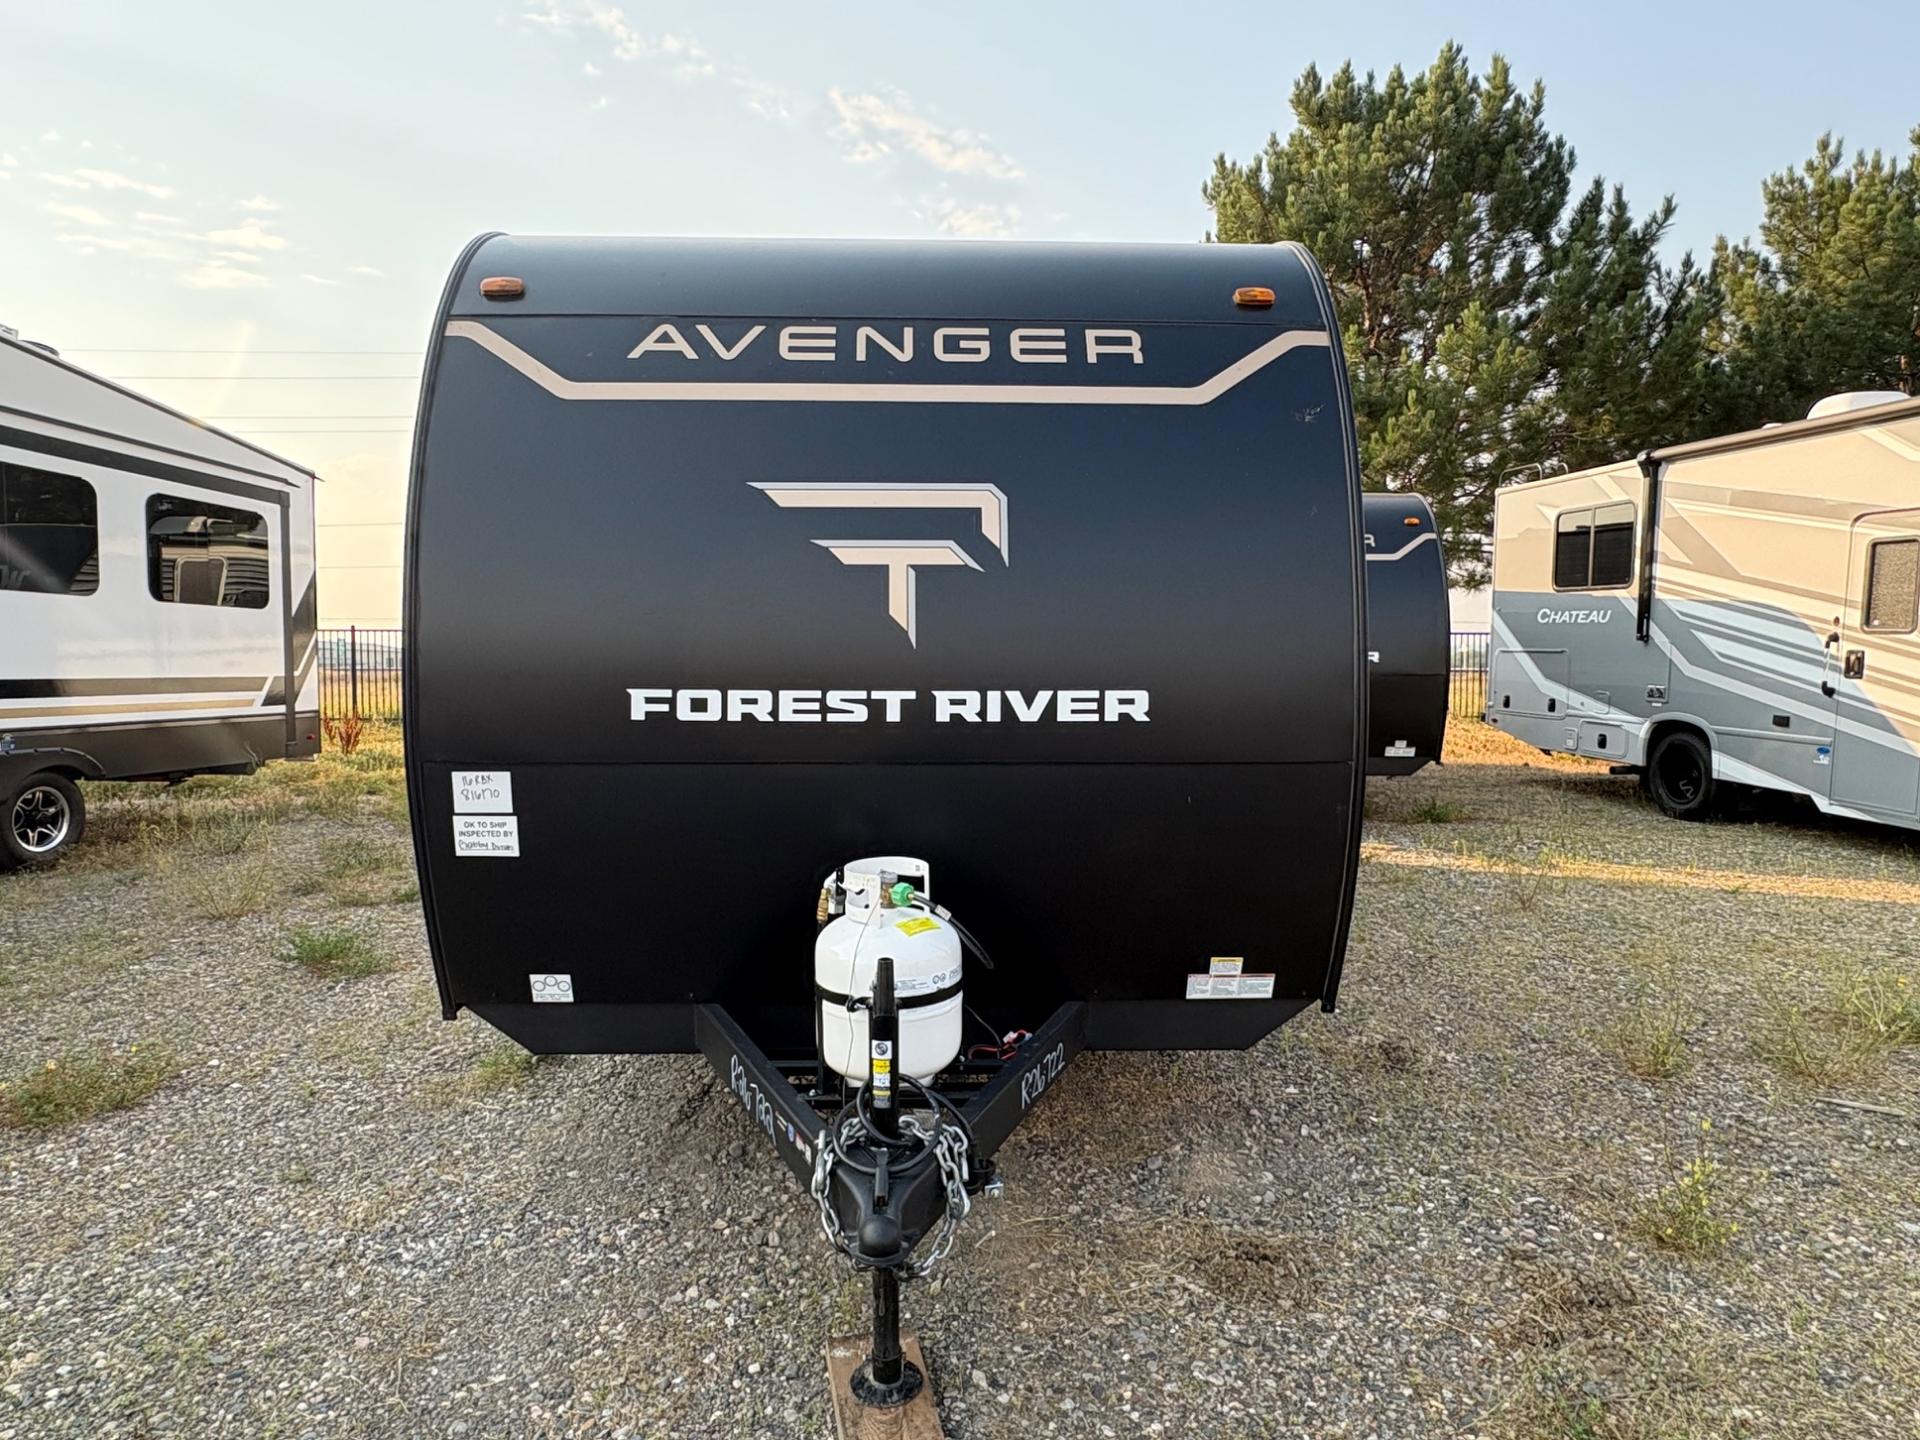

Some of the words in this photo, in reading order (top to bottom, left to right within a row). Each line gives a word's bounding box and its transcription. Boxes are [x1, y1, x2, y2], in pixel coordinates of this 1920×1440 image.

[627, 324, 1145, 364] AVENGER
[1537, 608, 1612, 624] CHATEAU
[626, 688, 916, 722] FOREST
[931, 690, 1150, 722] RIVER
[458, 830, 502, 838] INSPECTED
[503, 830, 514, 838] BY
